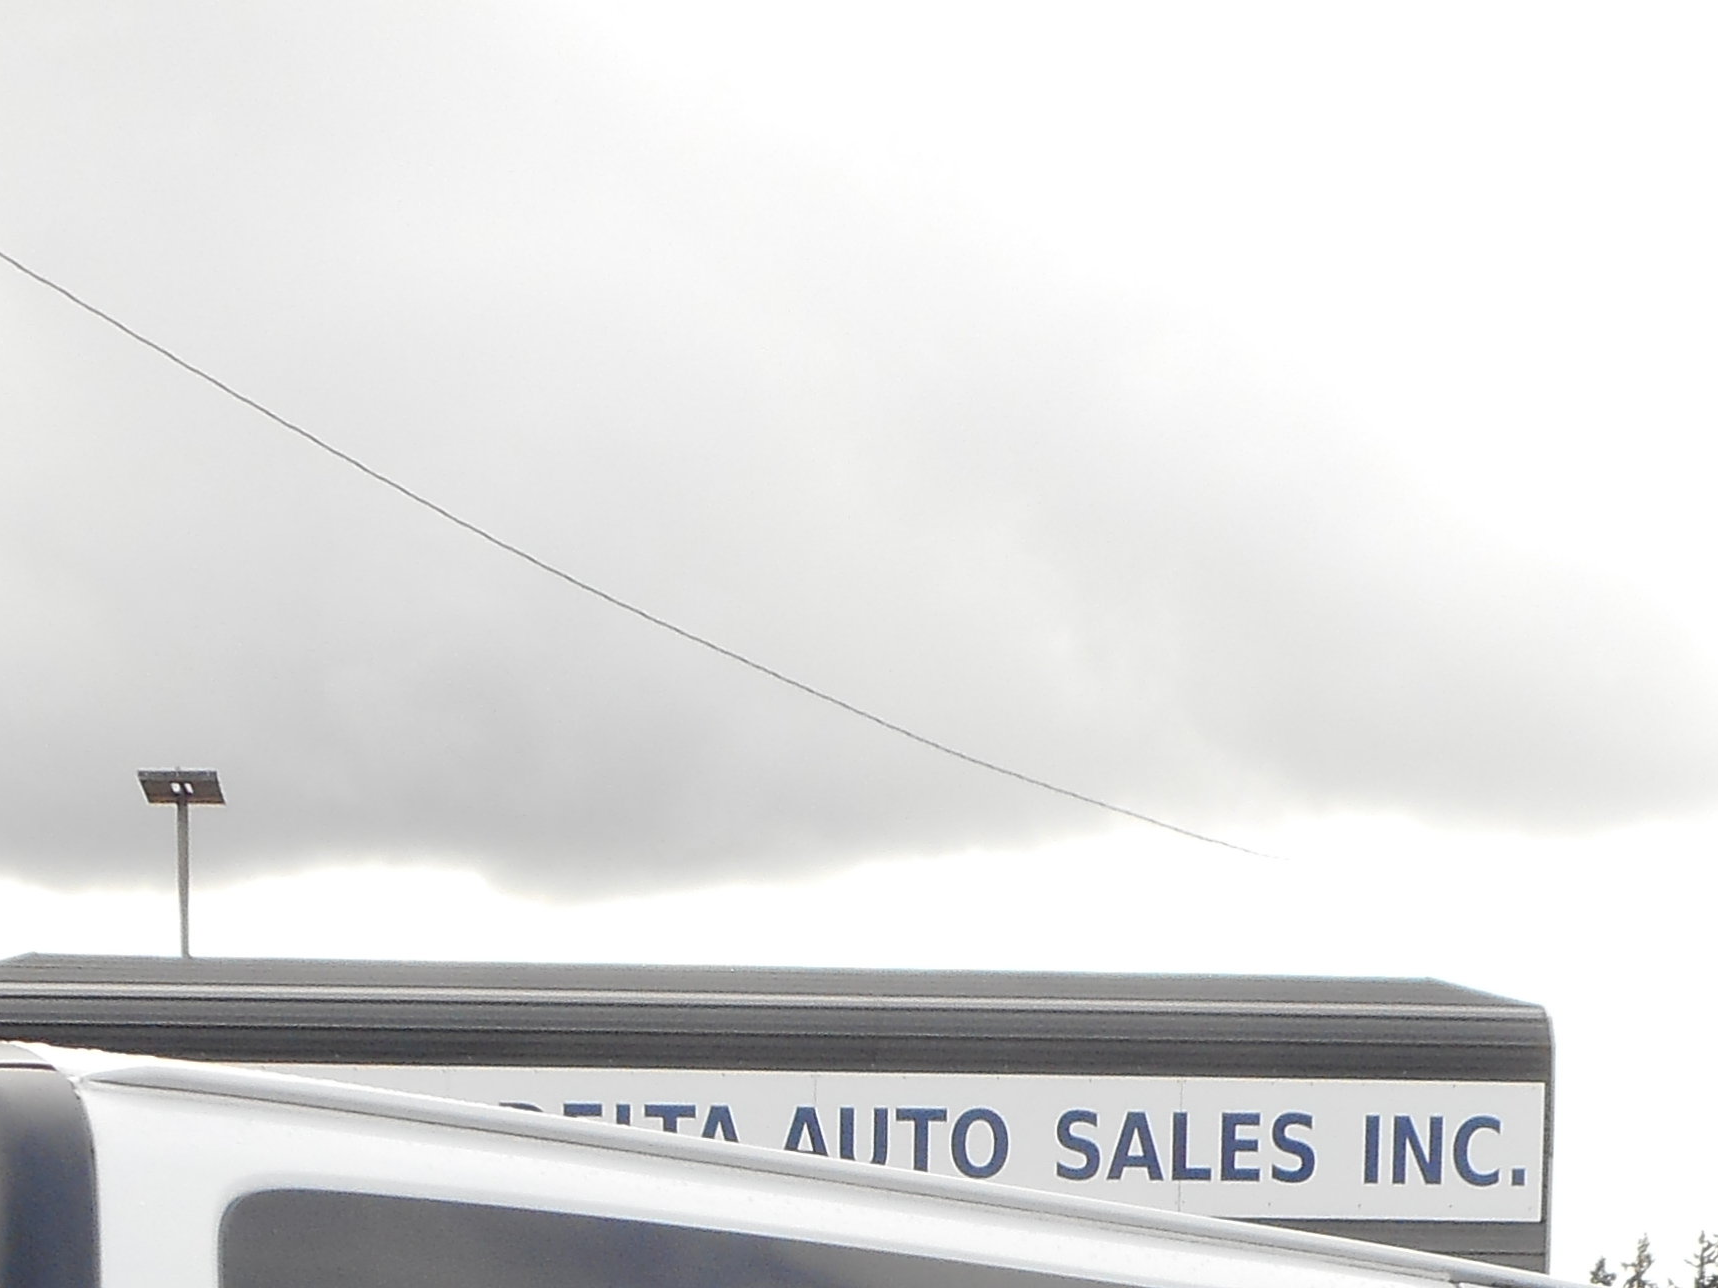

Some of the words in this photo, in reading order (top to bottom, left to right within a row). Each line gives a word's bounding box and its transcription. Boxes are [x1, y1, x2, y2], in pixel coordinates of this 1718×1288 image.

[783, 1105, 1010, 1180] AUTO
[1055, 1108, 1316, 1184] SALES
[1363, 1113, 1527, 1188] INC.
